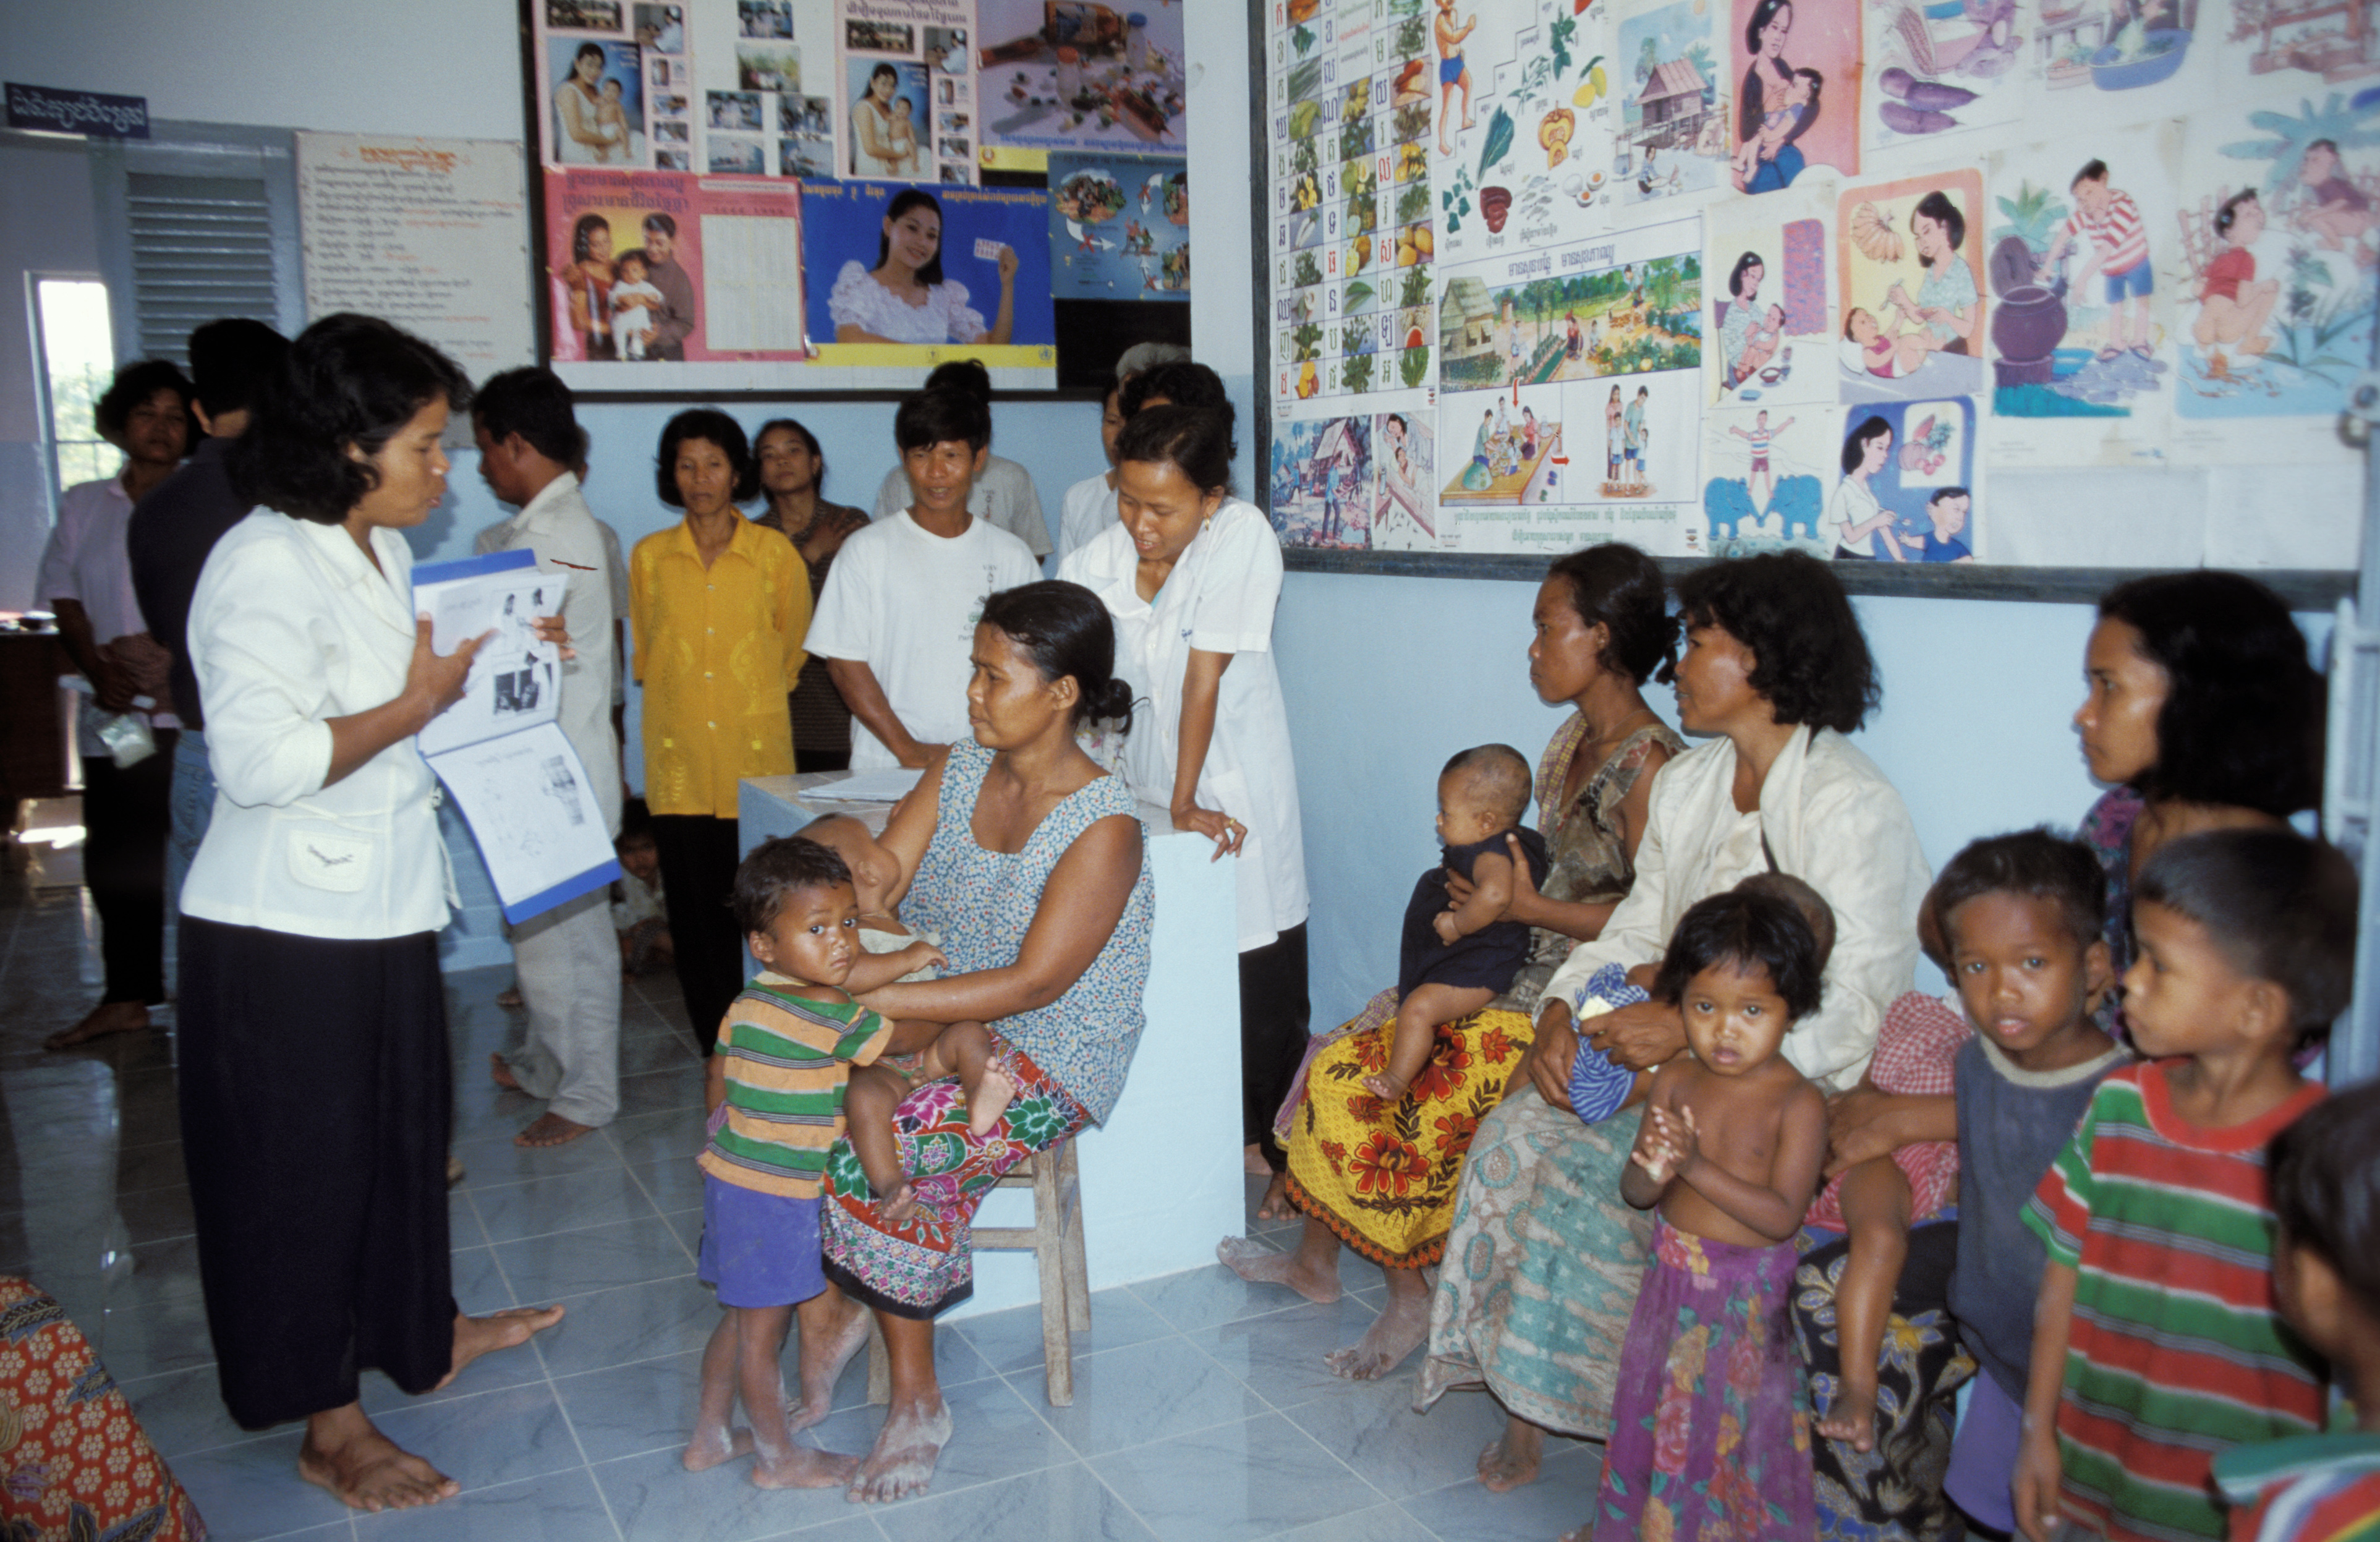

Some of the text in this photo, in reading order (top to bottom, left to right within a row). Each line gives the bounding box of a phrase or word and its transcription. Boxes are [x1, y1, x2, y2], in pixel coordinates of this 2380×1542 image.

[1276, 3, 1283, 27] ក
[1278, 40, 1283, 63] ខ
[1278, 79, 1283, 101] គ
[1376, 79, 1387, 105] យ
[1323, 97, 1337, 124] ណ
[1276, 115, 1287, 139] ឃ
[1380, 121, 1385, 145] រ
[1379, 156, 1390, 182] ល
[1330, 211, 1335, 234] ទ
[1380, 238, 1392, 263] ស
[1330, 289, 1336, 312] ន
[1380, 279, 1392, 303] ហ
[1278, 299, 1291, 321] ឈ
[1330, 328, 1337, 350] ប
[1381, 314, 1392, 347] ឡ
[1280, 331, 1290, 360] ញ
[1281, 372, 1287, 394] ដ
[1383, 360, 1391, 383] អ
